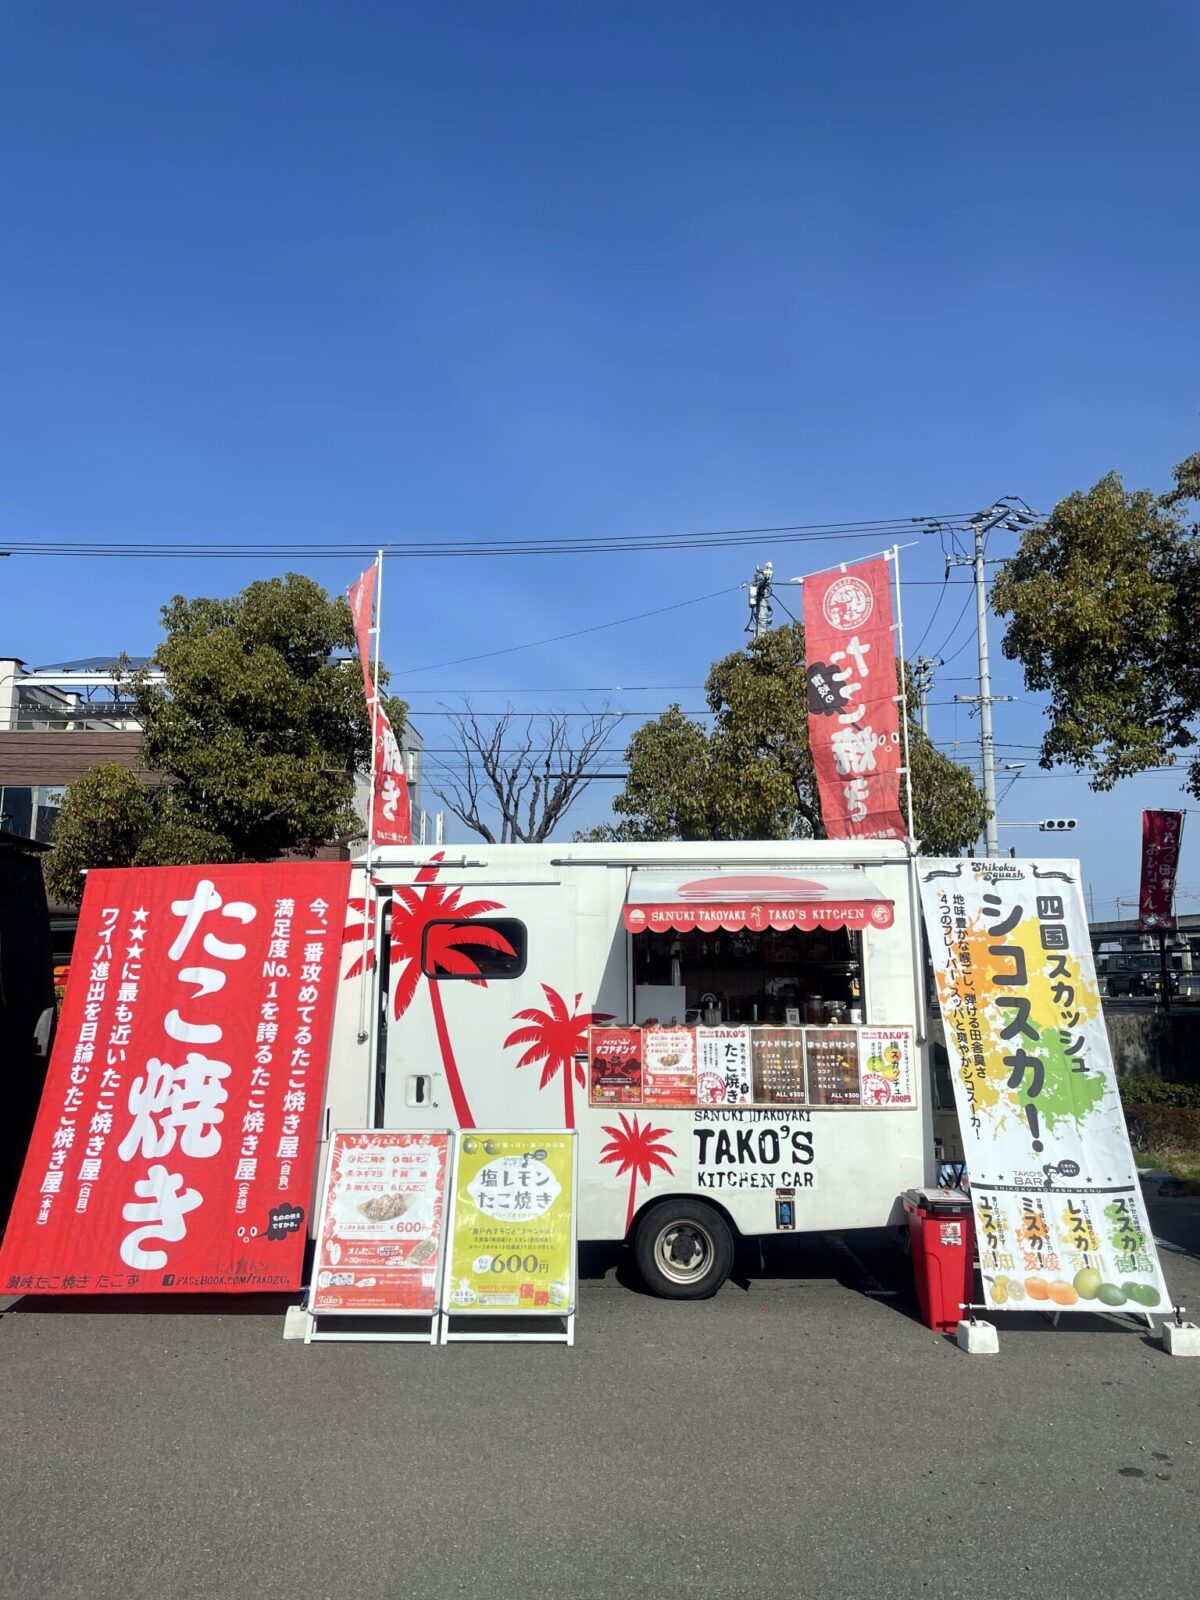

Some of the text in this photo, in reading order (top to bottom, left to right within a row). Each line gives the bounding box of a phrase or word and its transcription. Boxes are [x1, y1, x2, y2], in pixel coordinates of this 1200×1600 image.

[971, 861, 1016, 872] Shikoku
[984, 870, 1026, 886] Squash
[651, 908, 865, 922] SANUKI TAKOYAKI TAKO'S KITCHEN
[1036, 895, 1090, 1073] 四国スカッシュ
[982, 893, 1045, 1153] シコスカ！
[714, 1030, 746, 1038] TAKO'S
[877, 1031, 910, 1040] TAKO'S
[596, 1045, 637, 1054] タコヤキング
[753, 1040, 802, 1048] ソフトドリンク
[807, 1041, 856, 1049] ほっとドリンク
[117, 879, 257, 1271] たこ焼き
[725, 1043, 740, 1104] たこ焼き
[890, 1095, 912, 1103] 300円
[693, 1125, 815, 1165] TAKO'S
[356, 1170, 383, 1178] ネギマヨ
[480, 1169, 550, 1187] 塩レモン
[698, 1171, 814, 1188] KITCHEN CAR
[1013, 1170, 1044, 1178] TAKO'S
[1014, 1177, 1043, 1186] BAR
[994, 1185, 1072, 1193] SHIKOKU-SQUASH
[478, 1191, 552, 1210] たこ焼き
[5, 1274, 91, 1289] 讃岐たこ焼き
[318, 1295, 343, 1307] Tako's
